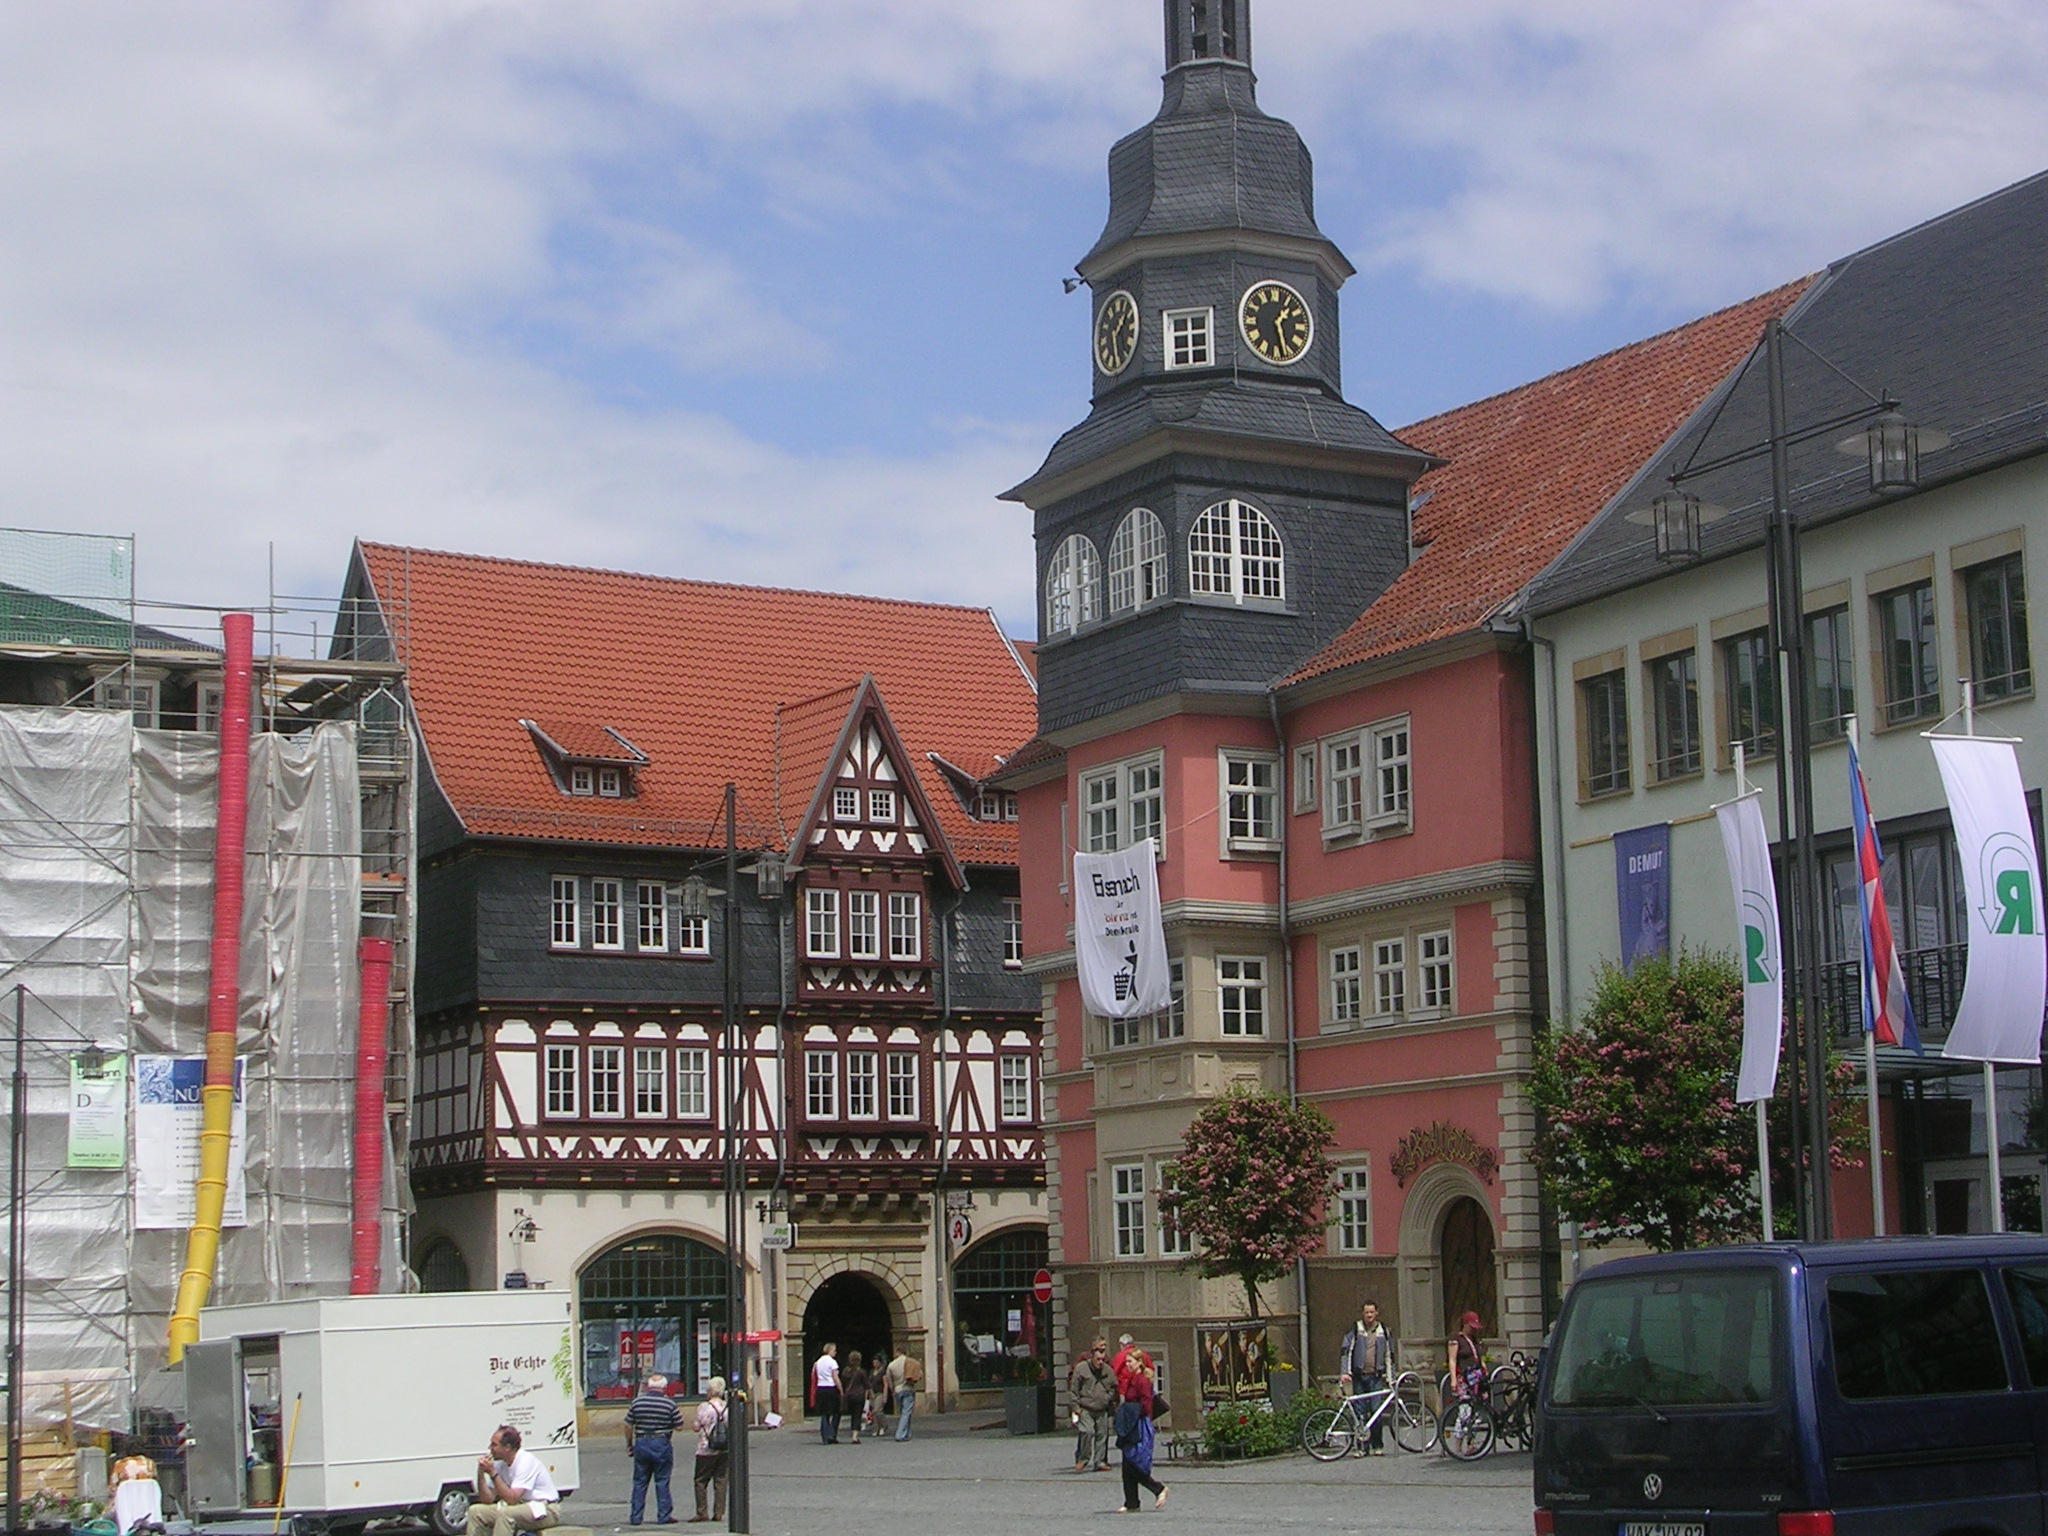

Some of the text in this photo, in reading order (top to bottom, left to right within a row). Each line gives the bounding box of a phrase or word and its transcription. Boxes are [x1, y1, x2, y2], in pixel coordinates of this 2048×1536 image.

[1629, 851, 1663, 874] DEMUT
[490, 1357, 509, 1373] Die
[1760, 1493, 1783, 1502] TDI
